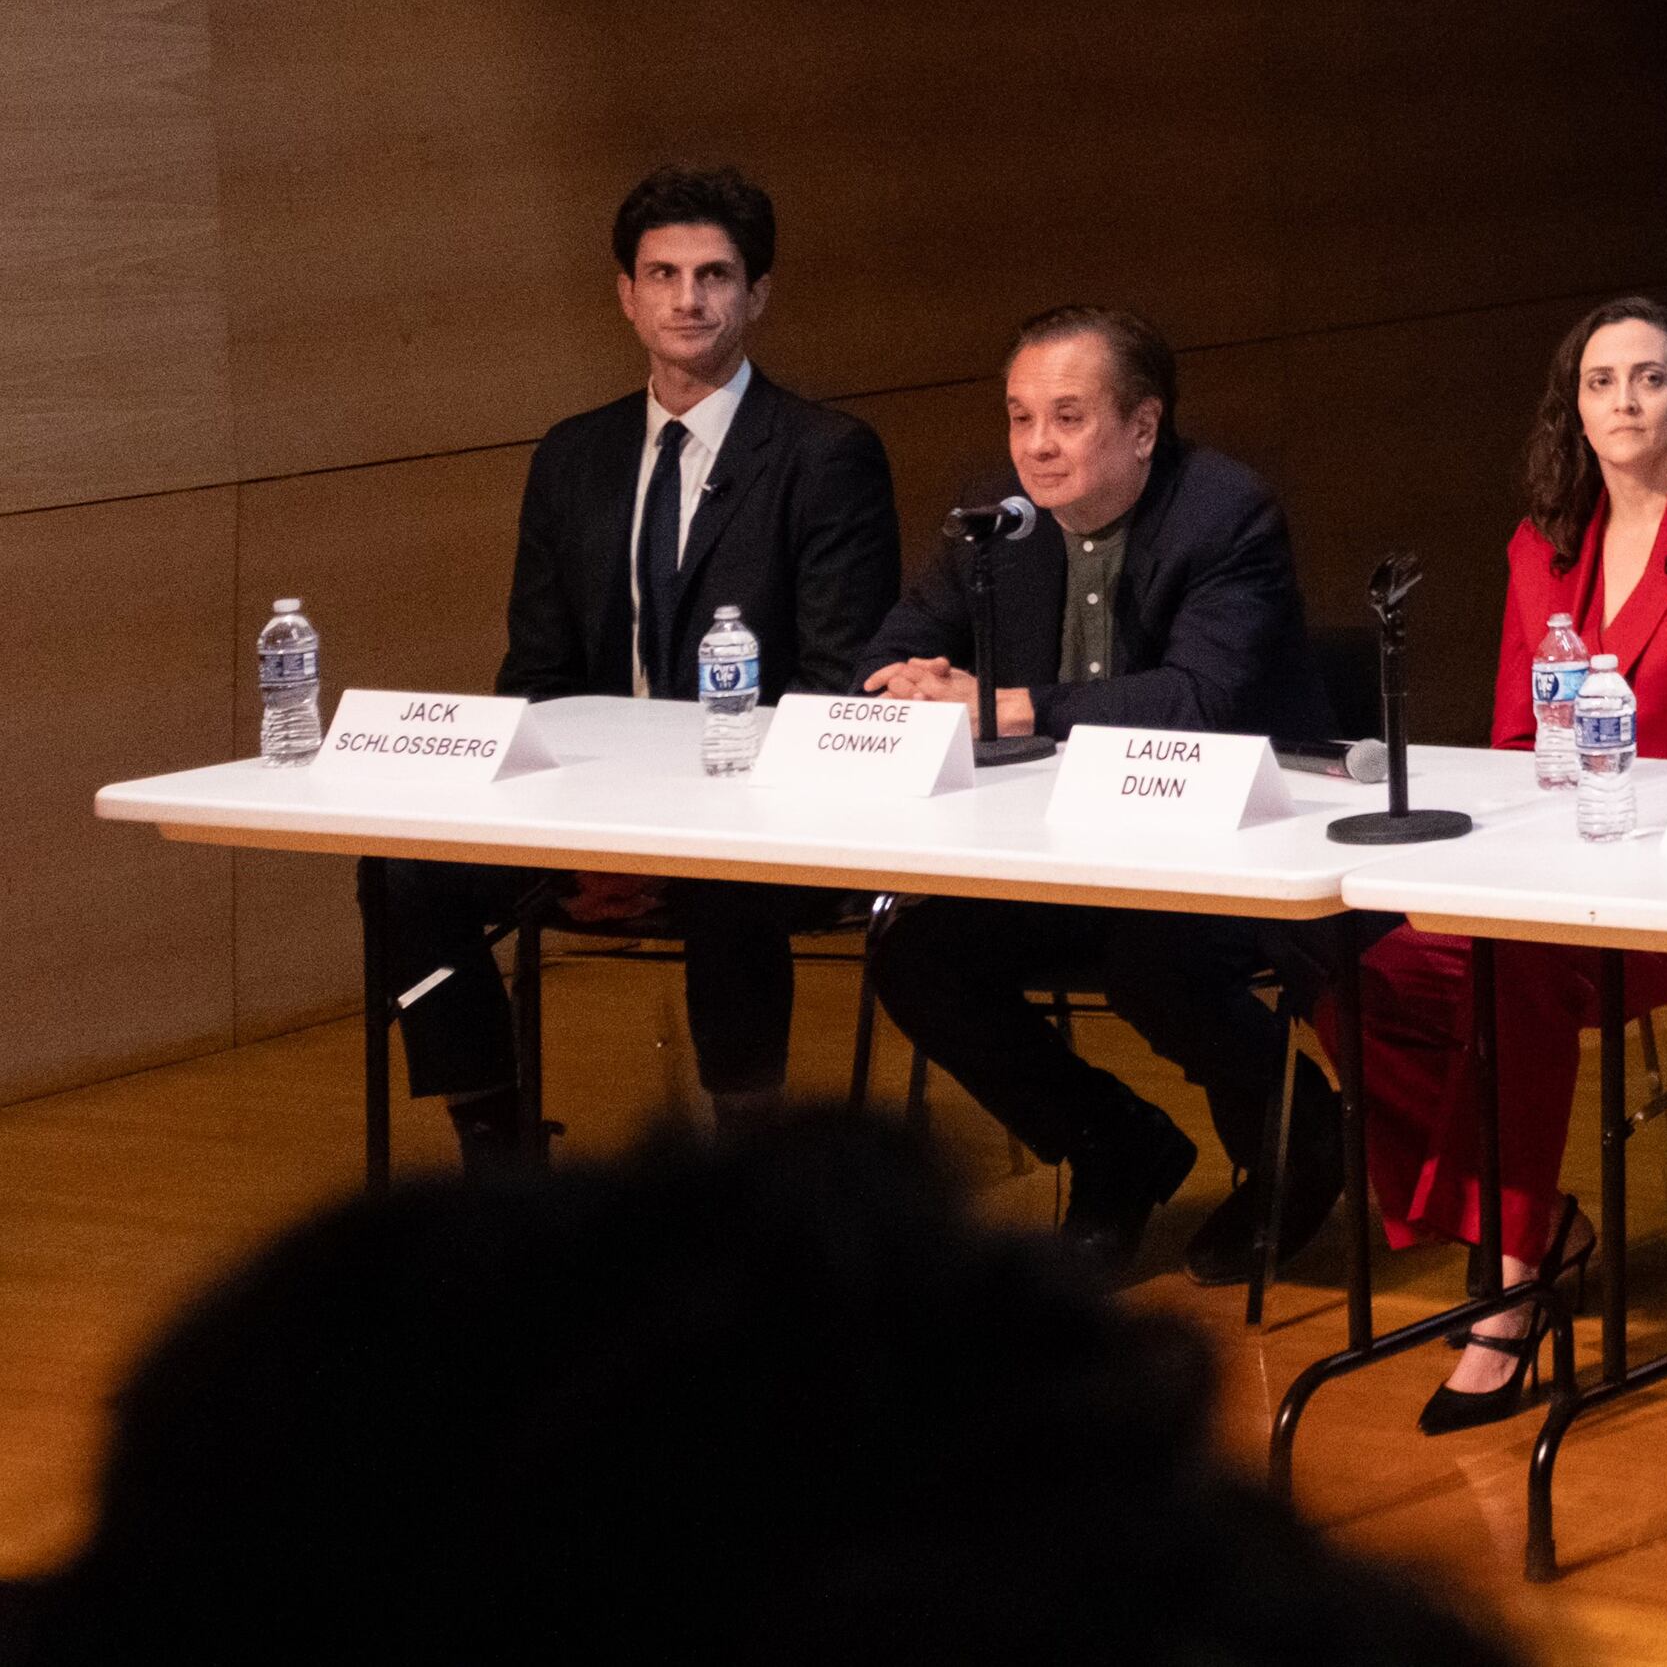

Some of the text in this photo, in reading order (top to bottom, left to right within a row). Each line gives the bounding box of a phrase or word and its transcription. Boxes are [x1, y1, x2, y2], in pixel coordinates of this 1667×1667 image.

[400, 701, 460, 723] JACK
[828, 702, 911, 724] GEORGE
[335, 733, 498, 759] SCHLOSSBERG
[817, 733, 902, 754] CONWAY
[1125, 739, 1201, 763] LAURA
[1121, 775, 1187, 799] DUNN
